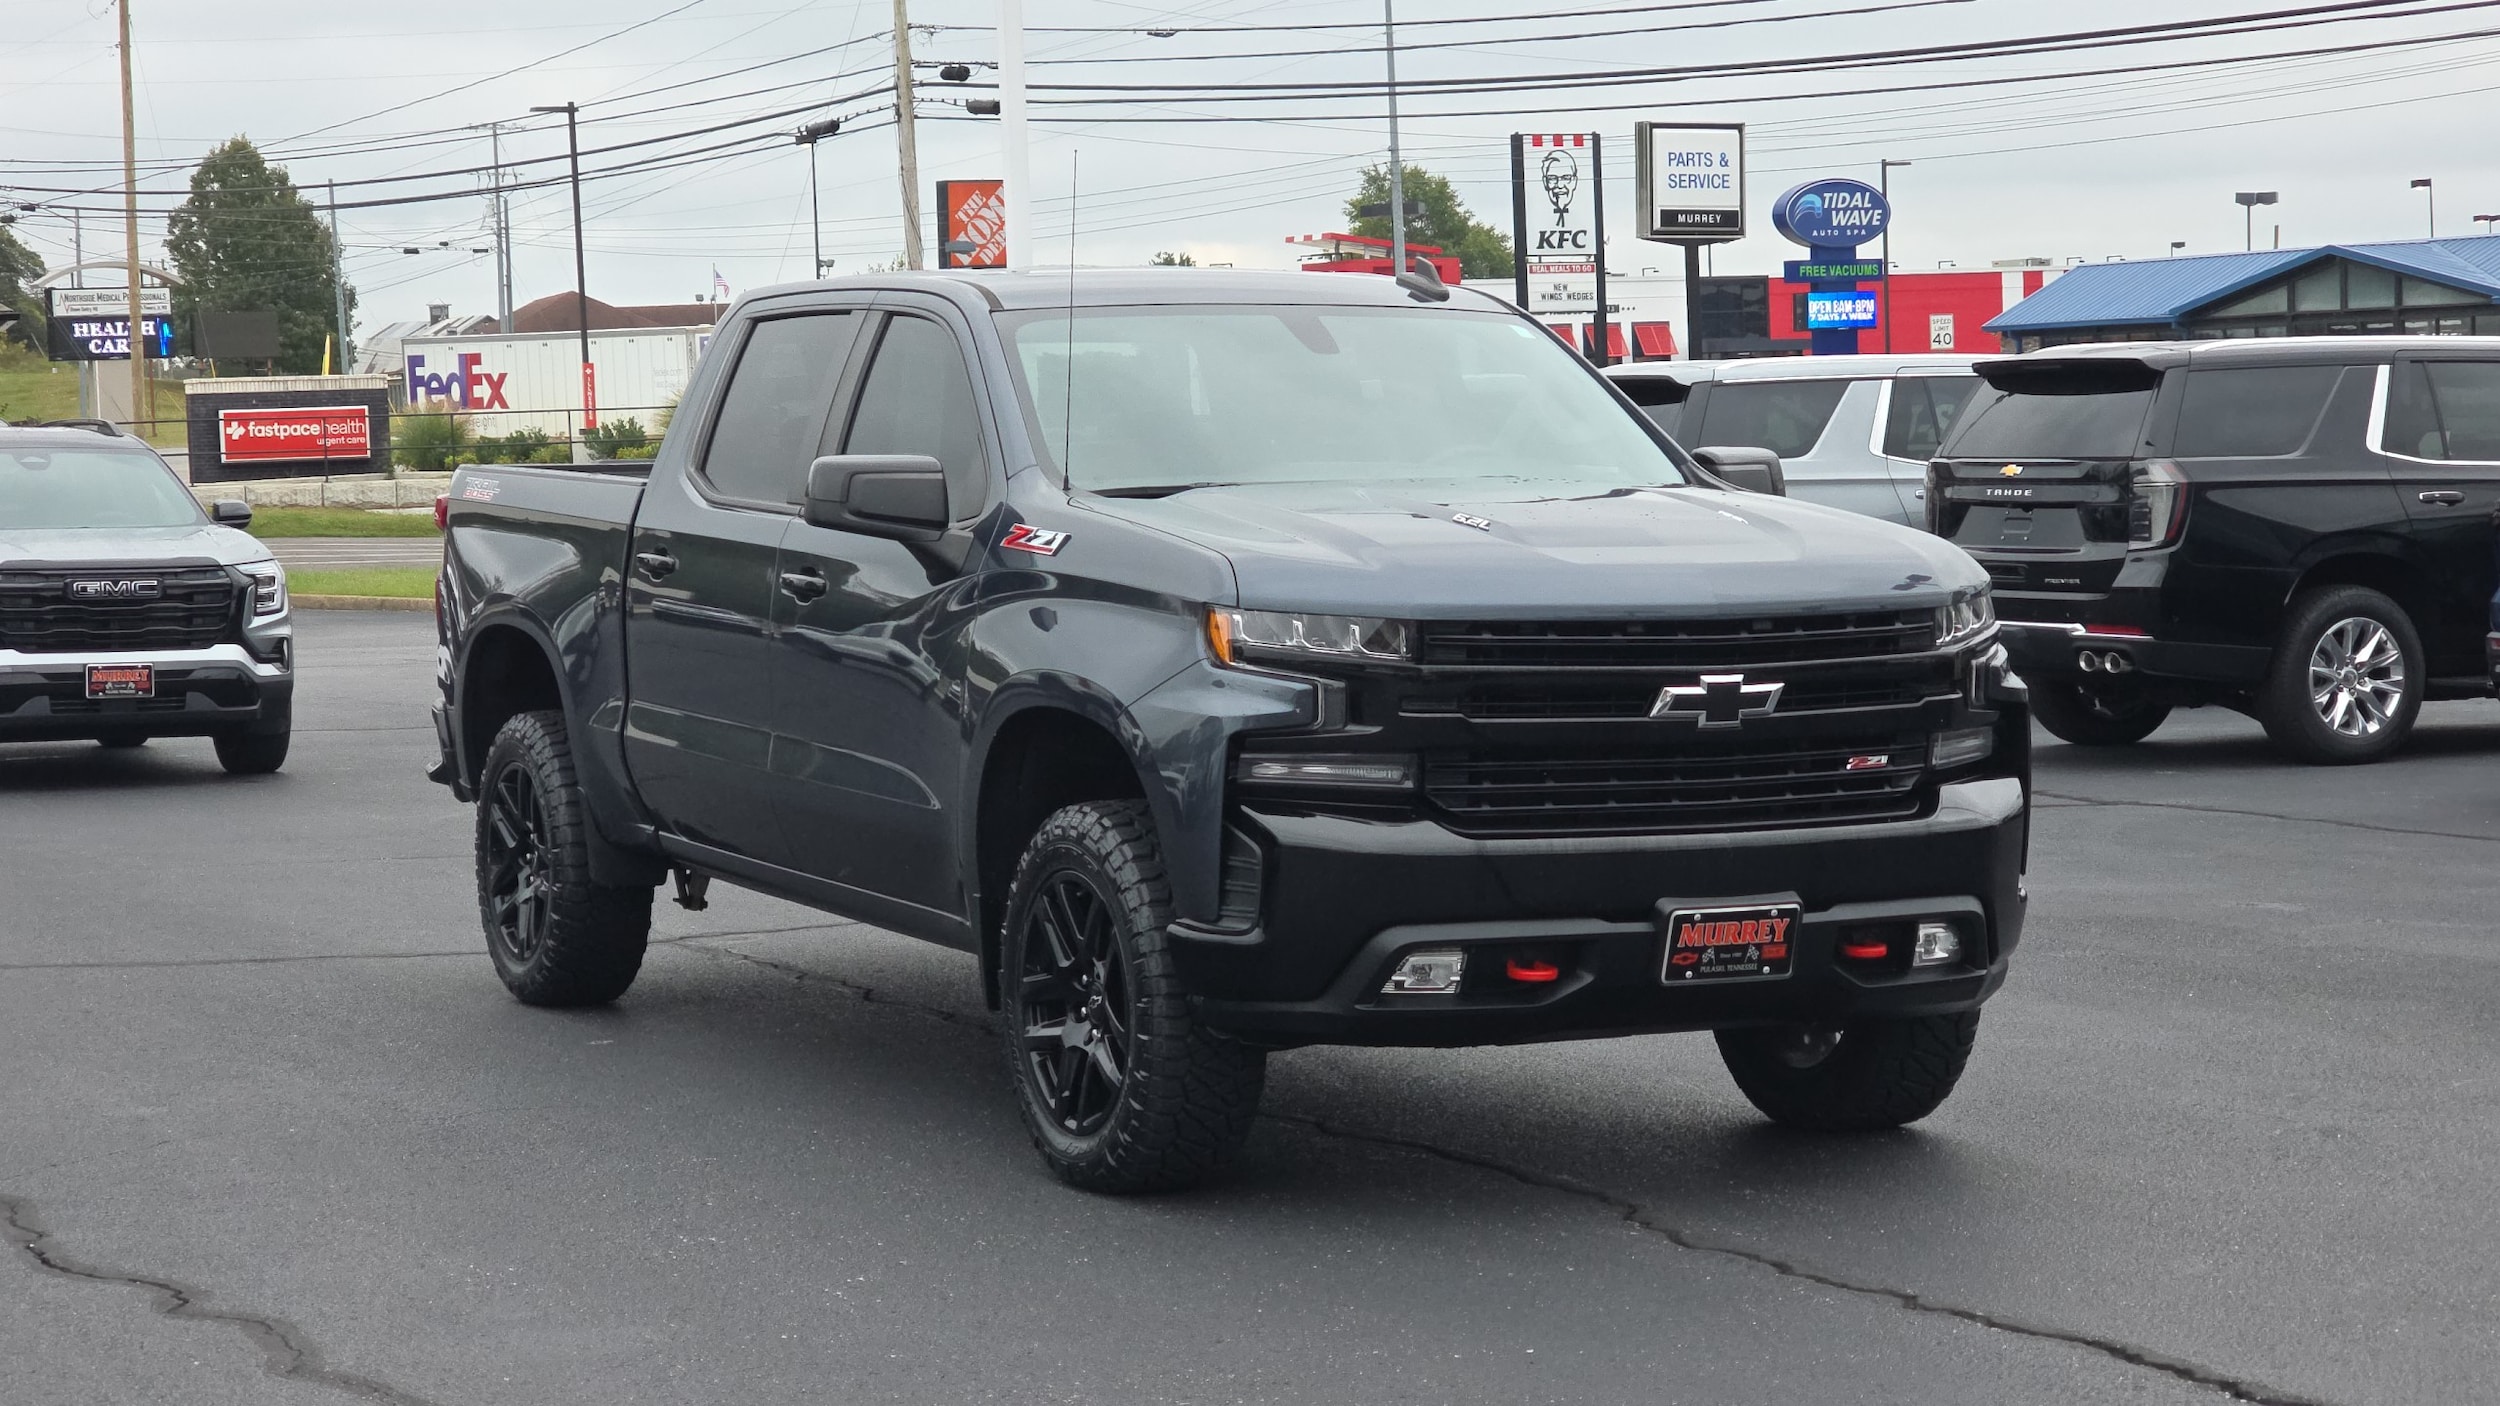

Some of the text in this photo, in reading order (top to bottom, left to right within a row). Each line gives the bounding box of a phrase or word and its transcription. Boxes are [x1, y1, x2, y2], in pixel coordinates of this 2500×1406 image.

[1668, 152, 1730, 167] PARTS &
[1668, 173, 1730, 189] SERVICE
[954, 190, 987, 224] THE
[1823, 192, 1872, 208] TIDAL
[1677, 213, 1722, 223] MURREY
[1831, 209, 1882, 226] WAVE
[1536, 230, 1587, 249] KFC
[1532, 265, 1549, 273] REAL
[1582, 264, 1592, 272] GO
[1800, 265, 1879, 277] FREE VACUUMS
[1553, 284, 1568, 292] NEW
[1566, 292, 1594, 300] WEDGES
[1808, 300, 1831, 313] OPEN
[1809, 313, 1816, 321] 7
[1817, 313, 1840, 321] DAYS
[1849, 312, 1874, 320] WEEK
[72, 321, 156, 337] HEALH
[1932, 332, 1952, 345] 40
[88, 338, 131, 354] CAR
[407, 353, 510, 410] FedEx
[316, 436, 345, 447] urgent
[463, 489, 493, 501] BOSS
[1000, 523, 1071, 555] Z71
[73, 580, 158, 598] GMC
[1846, 755, 1889, 769] Z71
[1677, 918, 1790, 948] MURREY
[1726, 963, 1758, 972] TENNESSEE
